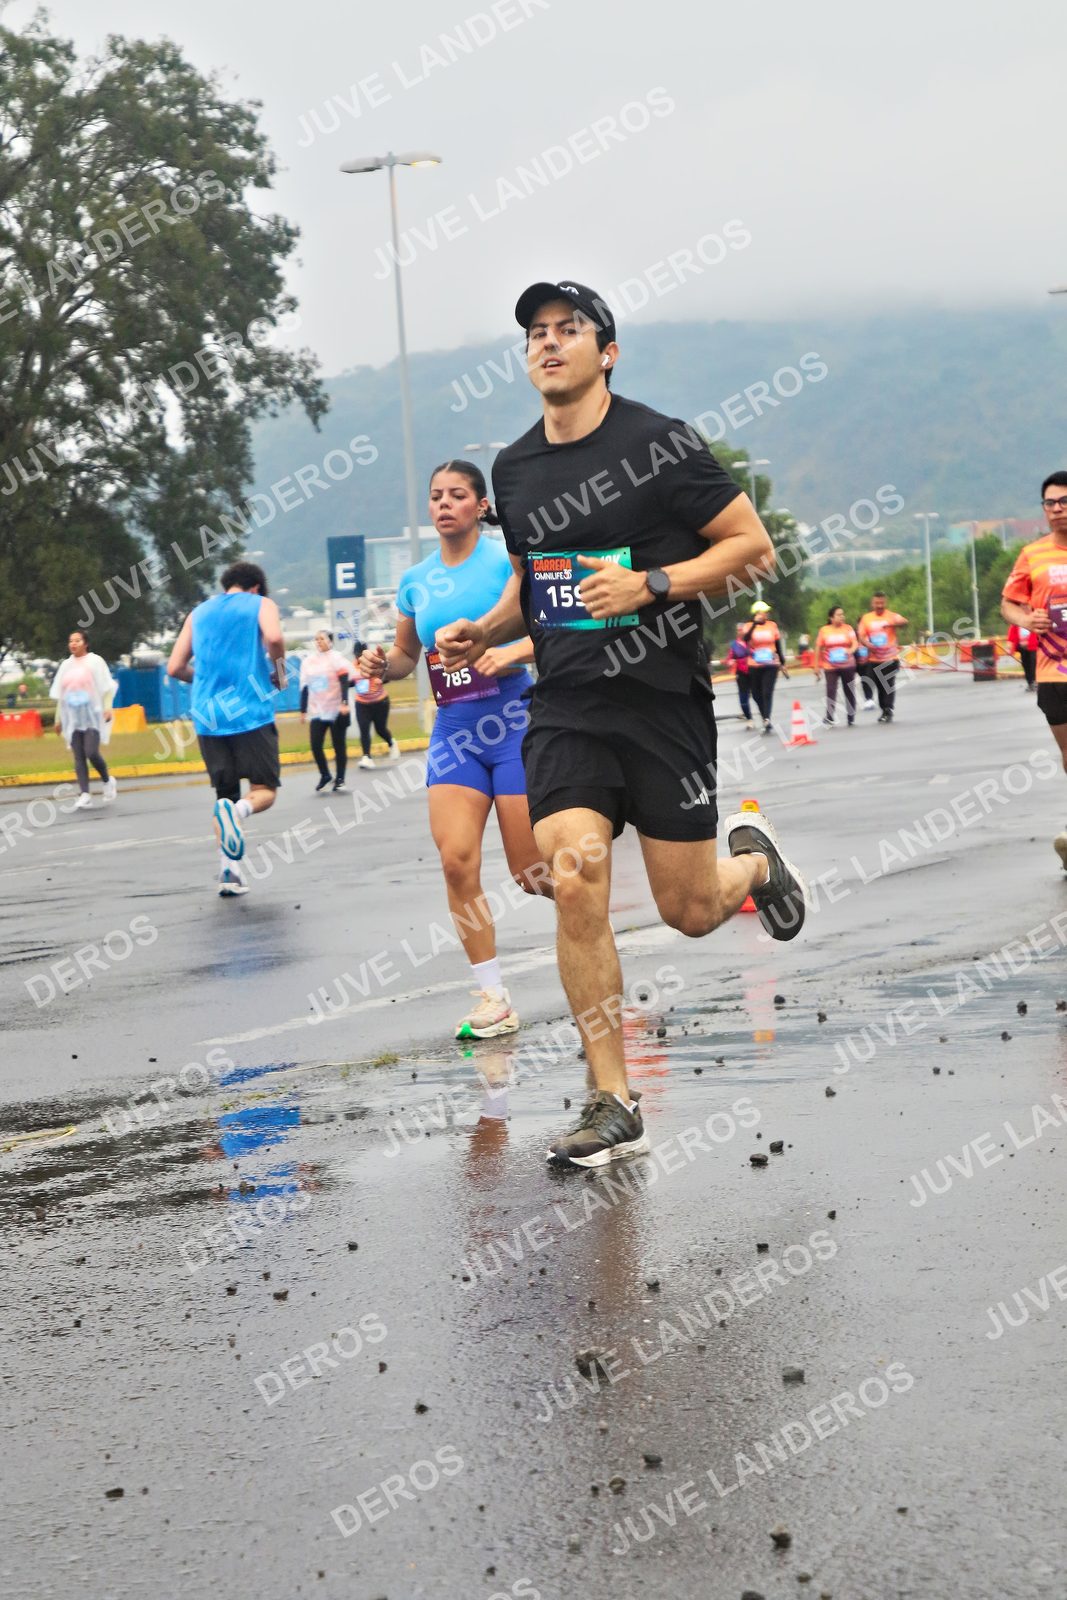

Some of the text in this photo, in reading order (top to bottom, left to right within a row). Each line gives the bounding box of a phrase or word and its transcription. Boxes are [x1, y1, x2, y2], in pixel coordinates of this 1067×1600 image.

[533, 558, 572, 572] CARRERA
[336, 562, 357, 590] E
[442, 667, 472, 688] 785
